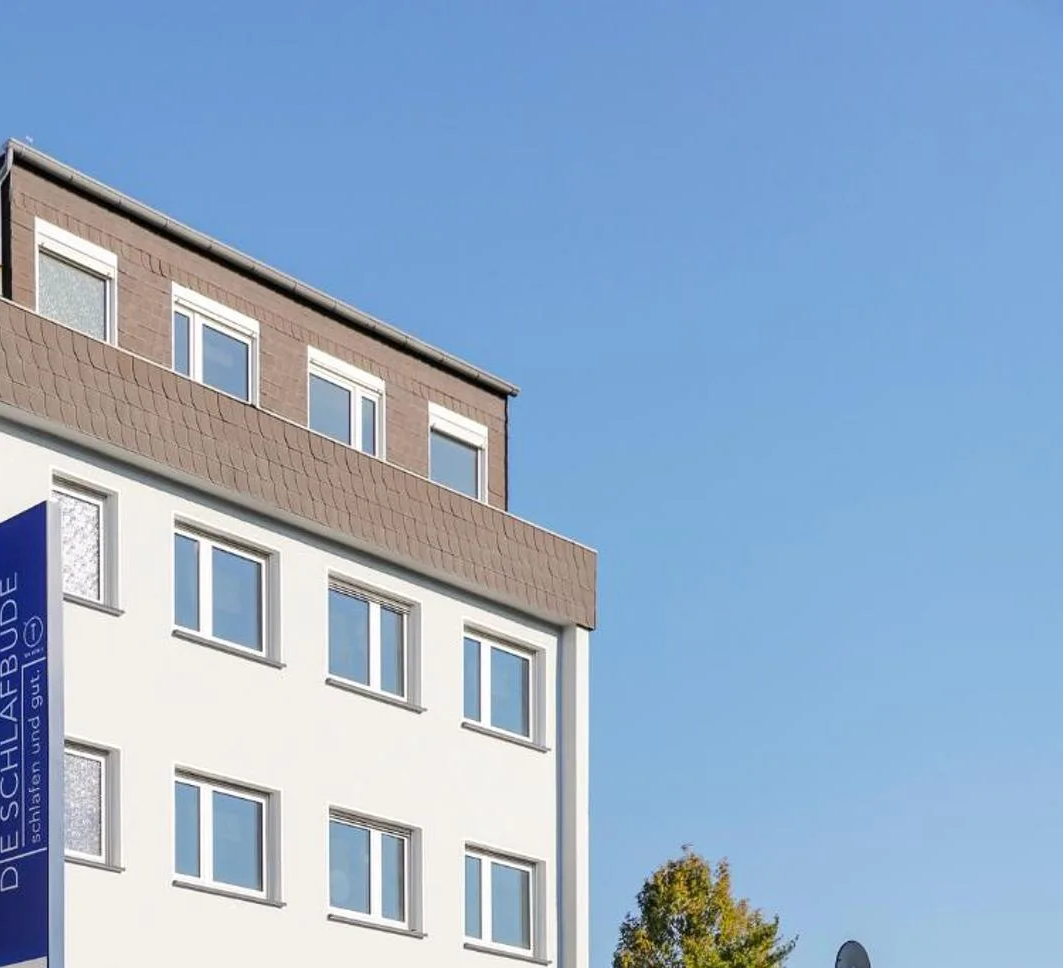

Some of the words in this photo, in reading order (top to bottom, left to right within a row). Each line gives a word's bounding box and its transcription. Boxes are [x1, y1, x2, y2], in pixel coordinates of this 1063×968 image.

[0, 571, 19, 822] SCHLAFBUDE
[29, 668, 44, 710] gut.
[28, 715, 41, 755] und
[28, 760, 41, 843] schlafen
